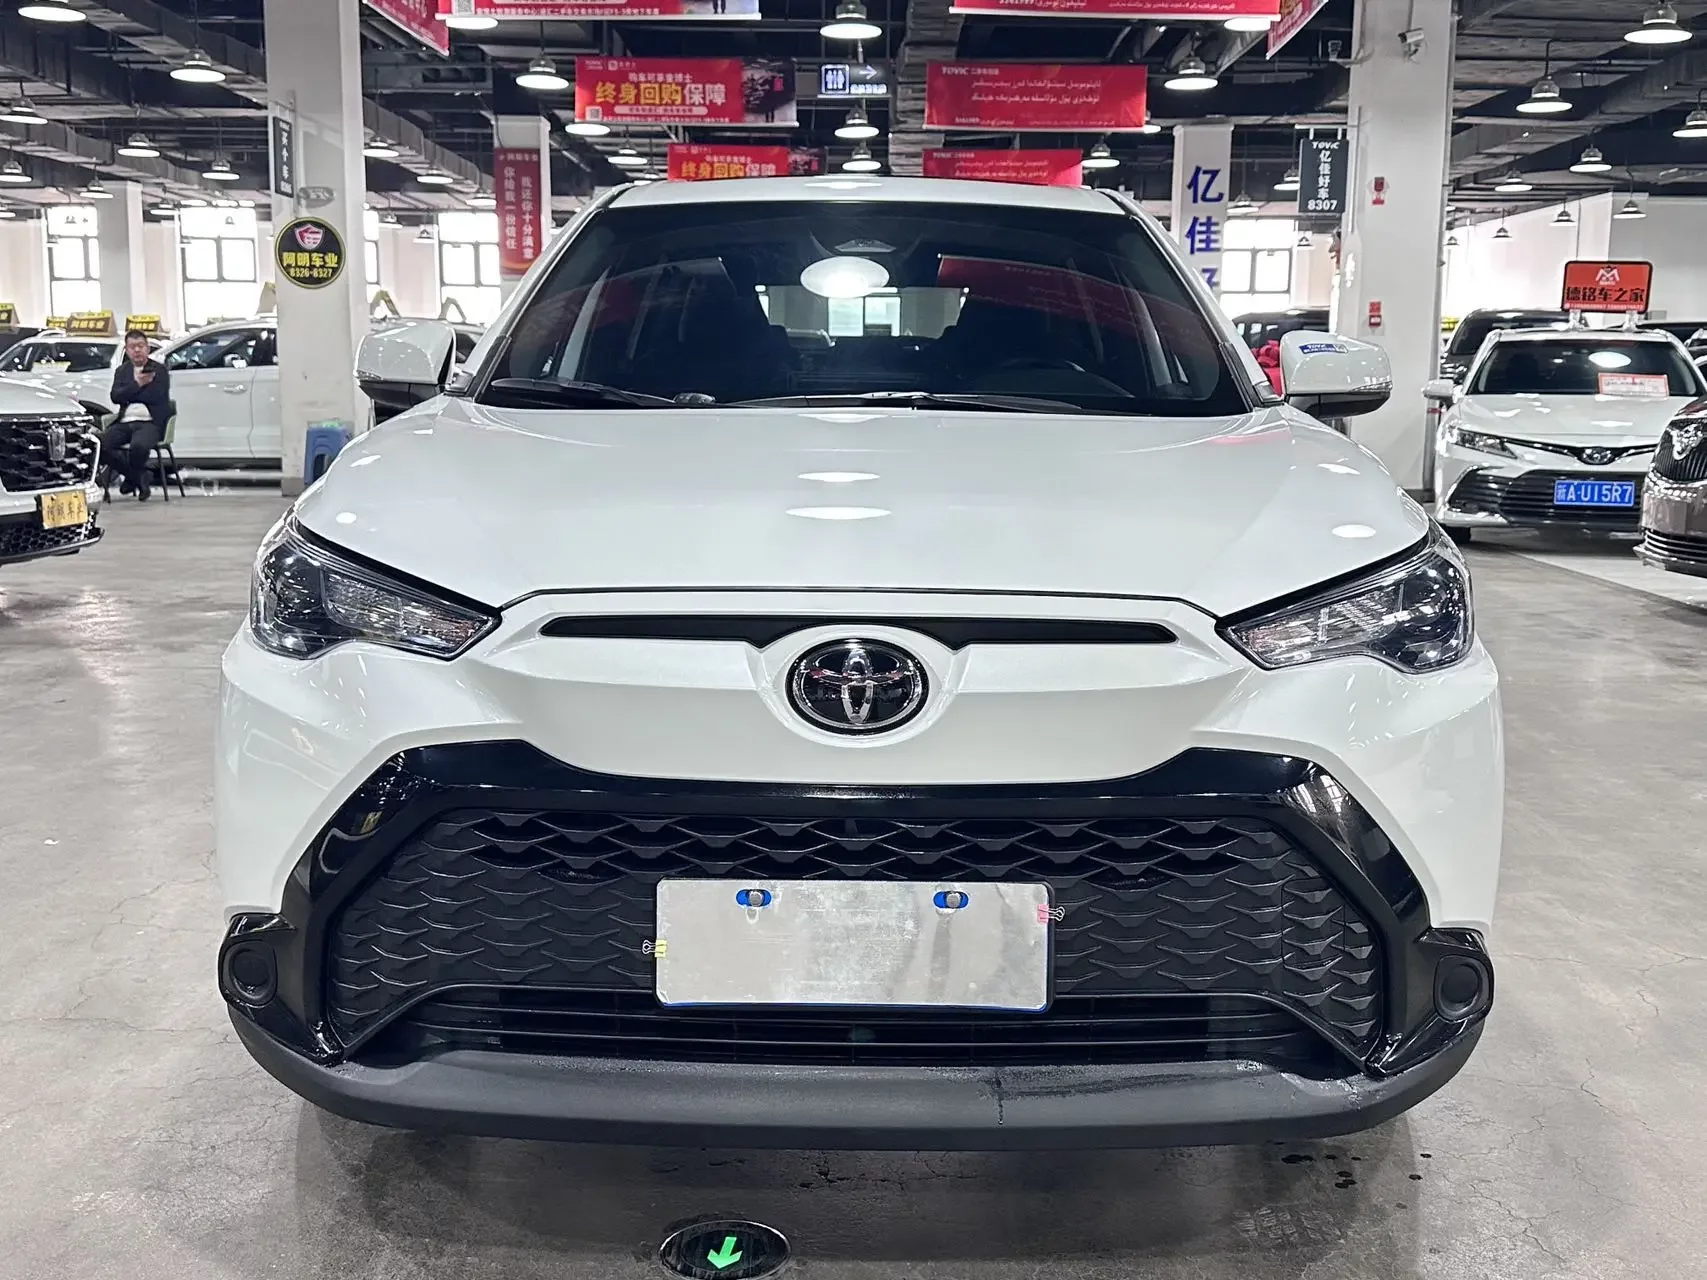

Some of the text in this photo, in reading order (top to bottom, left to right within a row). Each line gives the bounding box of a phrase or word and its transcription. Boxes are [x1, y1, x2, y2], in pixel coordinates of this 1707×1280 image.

[595, 82, 727, 106] 终身回购保障
[681, 160, 777, 178] 终身回购保障
[1317, 150, 1332, 199] 亿佳好车
[1307, 199, 1338, 211] 8307
[282, 252, 338, 268] 阿明车业
[1566, 286, 1646, 303] 德铭车之家
